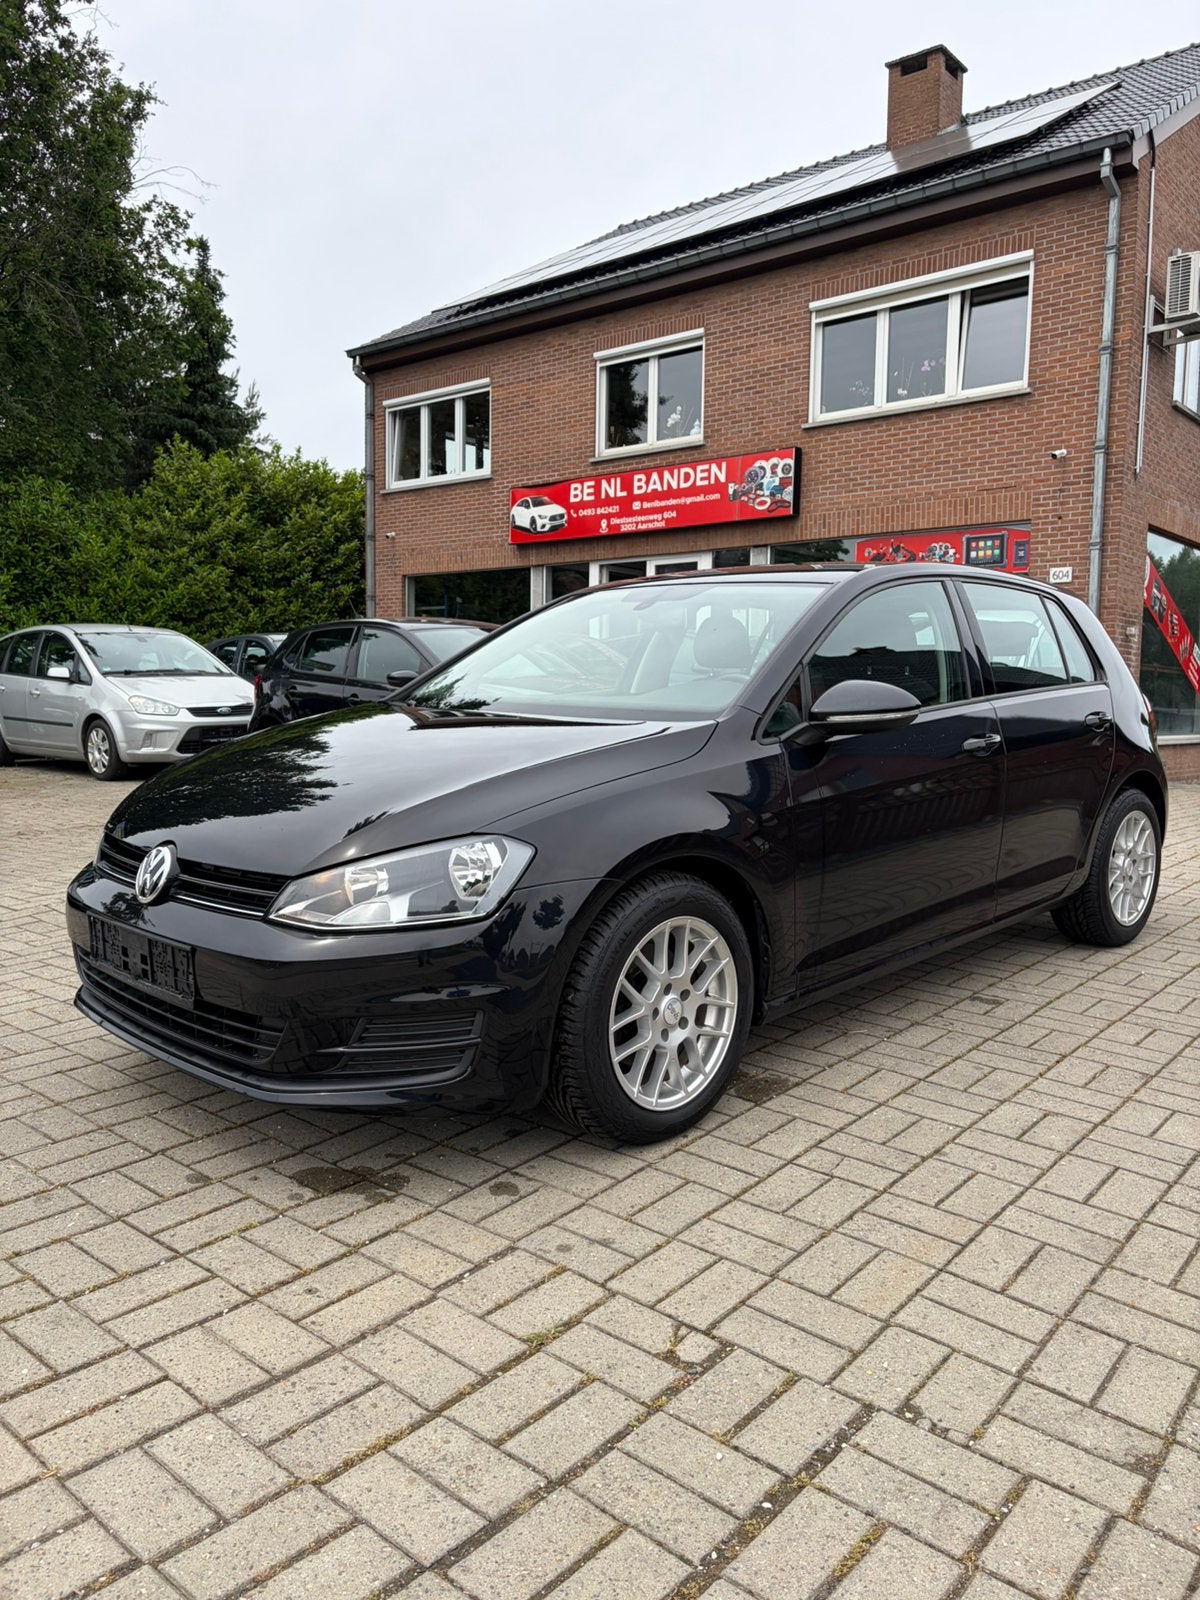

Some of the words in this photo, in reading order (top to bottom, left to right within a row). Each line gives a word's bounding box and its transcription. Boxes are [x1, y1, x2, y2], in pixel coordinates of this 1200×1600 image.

[569, 481, 595, 503] BE
[601, 477, 627, 499] NL
[633, 461, 727, 495] BANDEN
[578, 506, 595, 517] 0493
[596, 505, 619, 515] 842421
[663, 510, 677, 520] 604
[620, 522, 636, 532] 3202
[637, 520, 666, 530] Aarschot
[1052, 570, 1070, 580] 604
